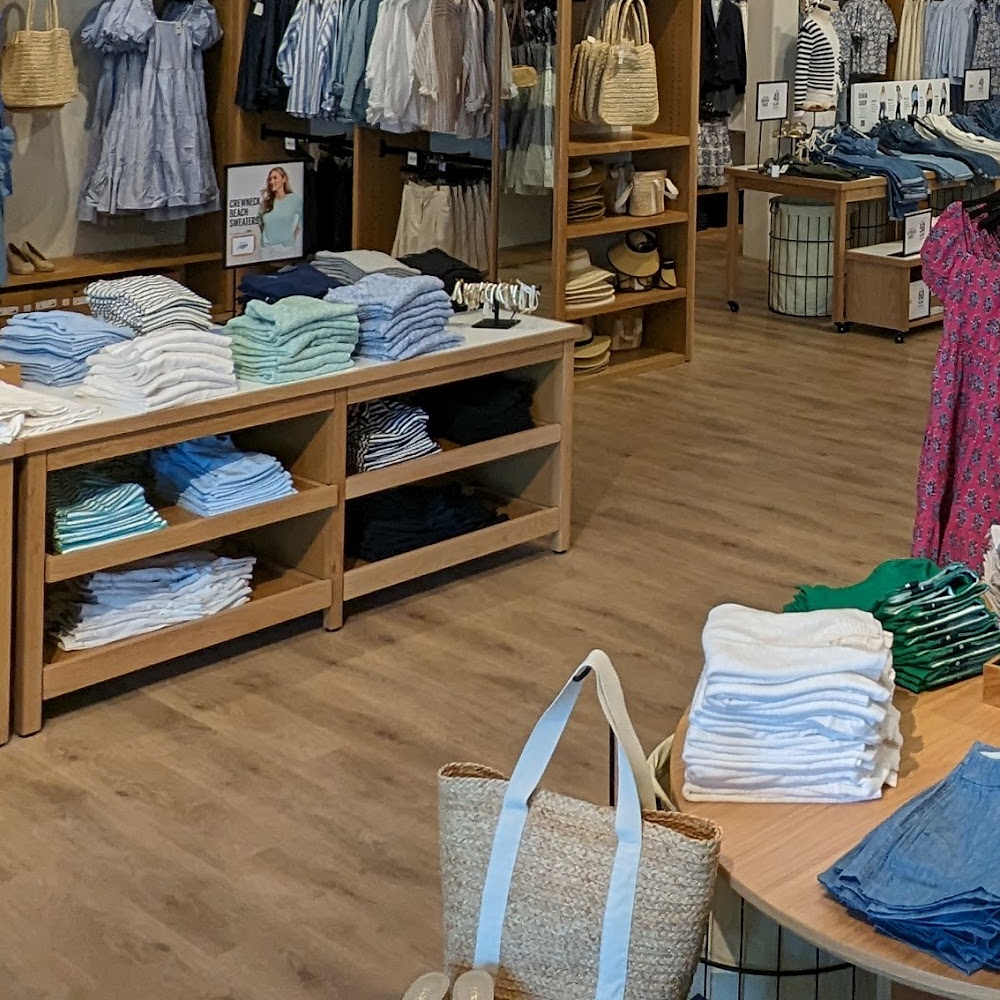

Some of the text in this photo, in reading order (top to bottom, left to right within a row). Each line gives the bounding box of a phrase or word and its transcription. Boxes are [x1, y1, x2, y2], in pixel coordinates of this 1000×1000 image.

[230, 198, 260, 208] CREWNECK
[230, 208, 249, 218] BEACH
[230, 217, 260, 228] SWEATERS
